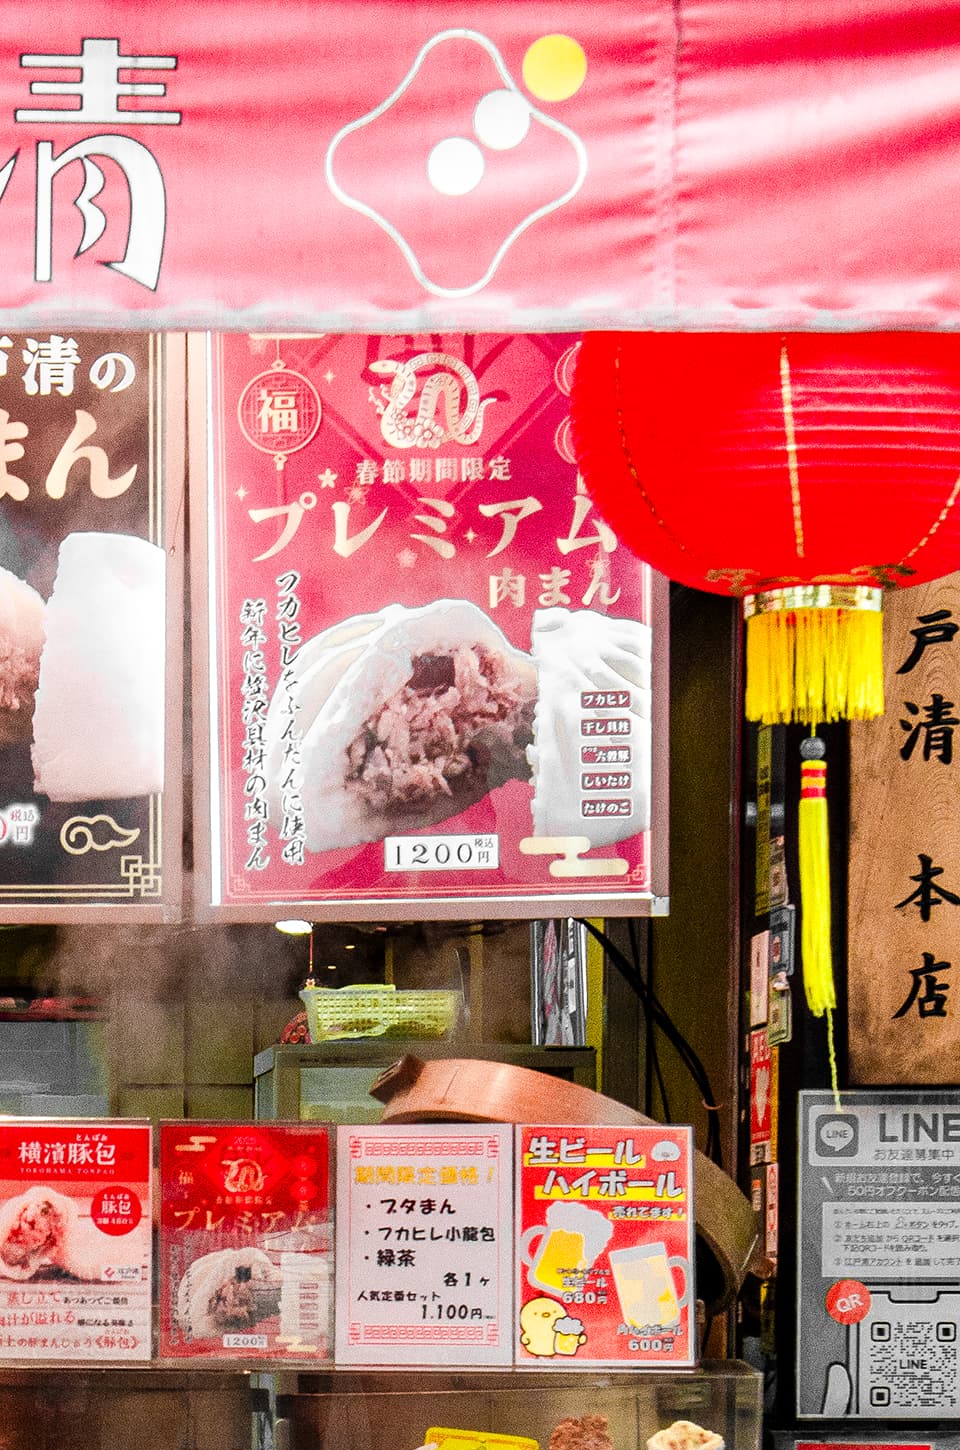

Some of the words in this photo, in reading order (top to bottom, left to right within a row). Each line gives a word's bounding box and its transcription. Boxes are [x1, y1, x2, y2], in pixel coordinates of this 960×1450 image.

[258, 389, 299, 434] 福
[355, 456, 513, 485] 春節期間限定
[248, 491, 618, 564] プレミアム
[489, 567, 622, 609] 肉まん
[583, 693, 629, 706] フカヒレ
[276, 571, 305, 865] フカヒレをふんだんに使用
[584, 775, 630, 787] しいたけ
[583, 801, 630, 814] たけのこ
[826, 1129, 849, 1139] LINE
[878, 1112, 960, 1143] LINE
[18, 1141, 116, 1166] 横濱豚包
[528, 1137, 642, 1165] 生ビール
[543, 1169, 683, 1198] ハイボール
[101, 1201, 131, 1215] 豚包
[376, 1249, 416, 1267] 緑茶
[357, 1291, 441, 1302] 人気定番セット
[835, 1292, 863, 1313] QR
[899, 1359, 928, 1370] LINE
